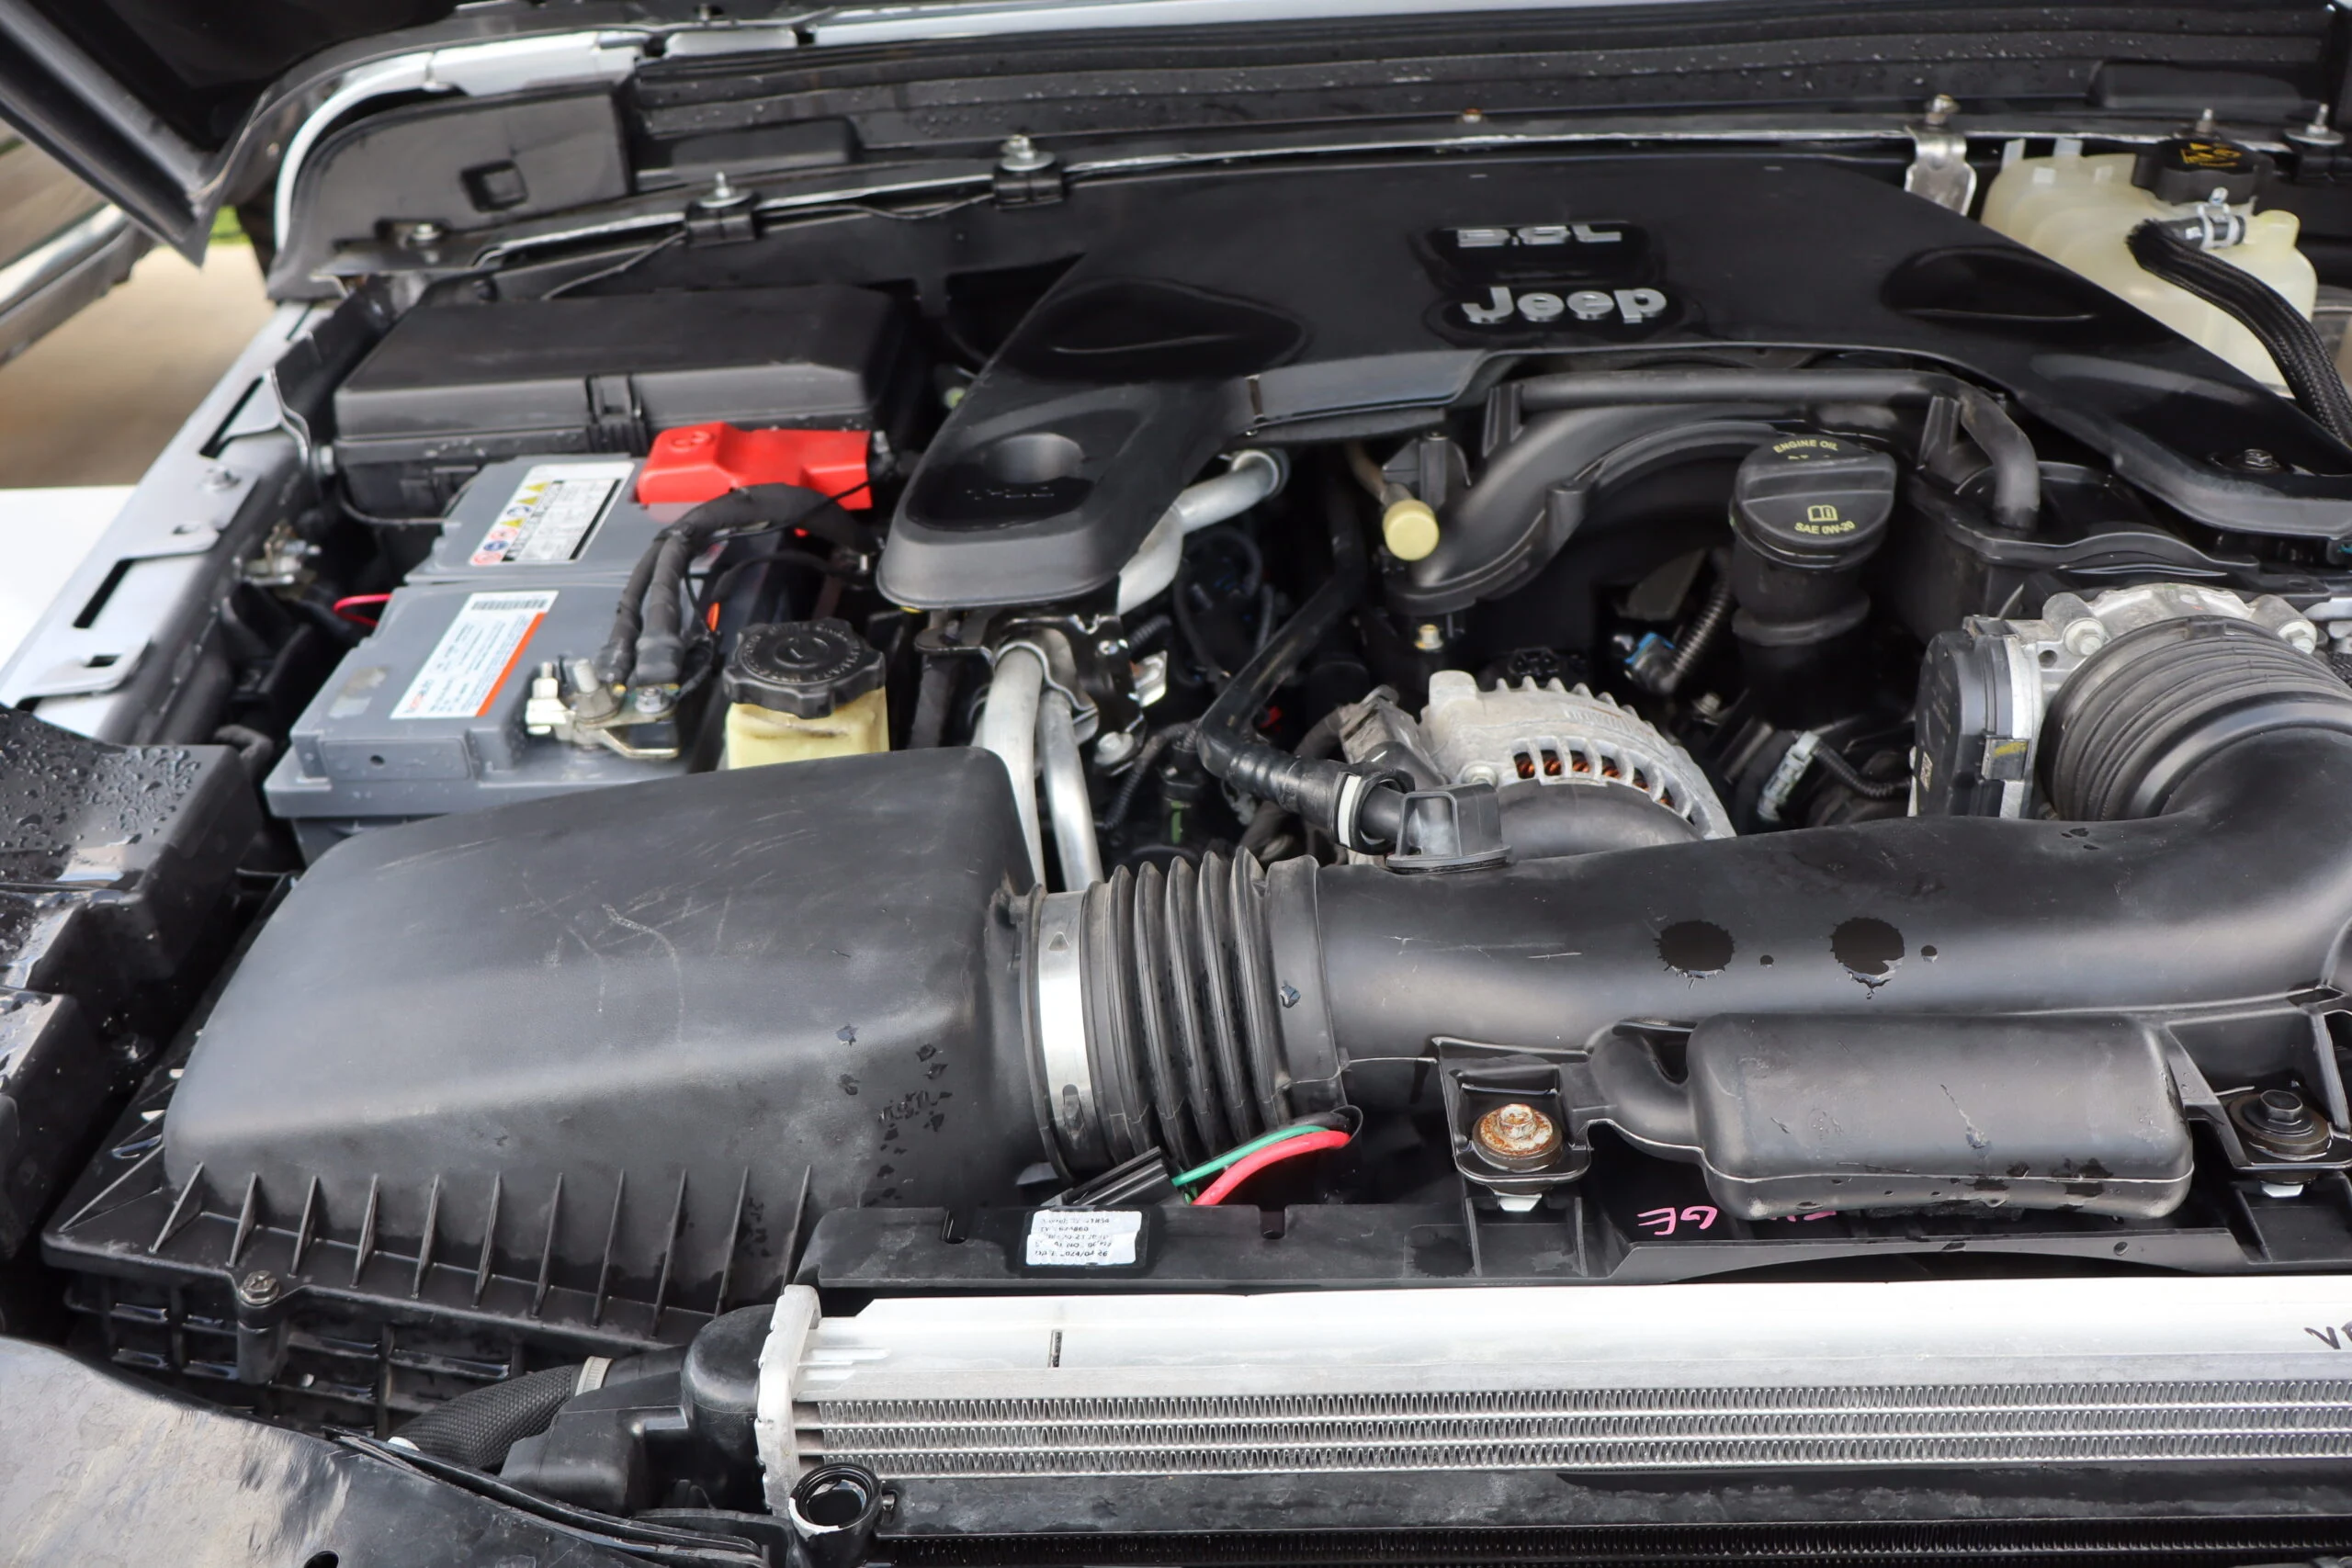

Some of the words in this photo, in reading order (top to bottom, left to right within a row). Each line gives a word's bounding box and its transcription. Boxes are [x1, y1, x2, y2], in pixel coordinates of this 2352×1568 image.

[1461, 286, 1668, 324] Jeep
[1772, 439, 1817, 454] ENGINE
[1820, 439, 1839, 451] OIL
[1793, 522, 1820, 535] SAE
[1822, 521, 1856, 535] 0W-20
